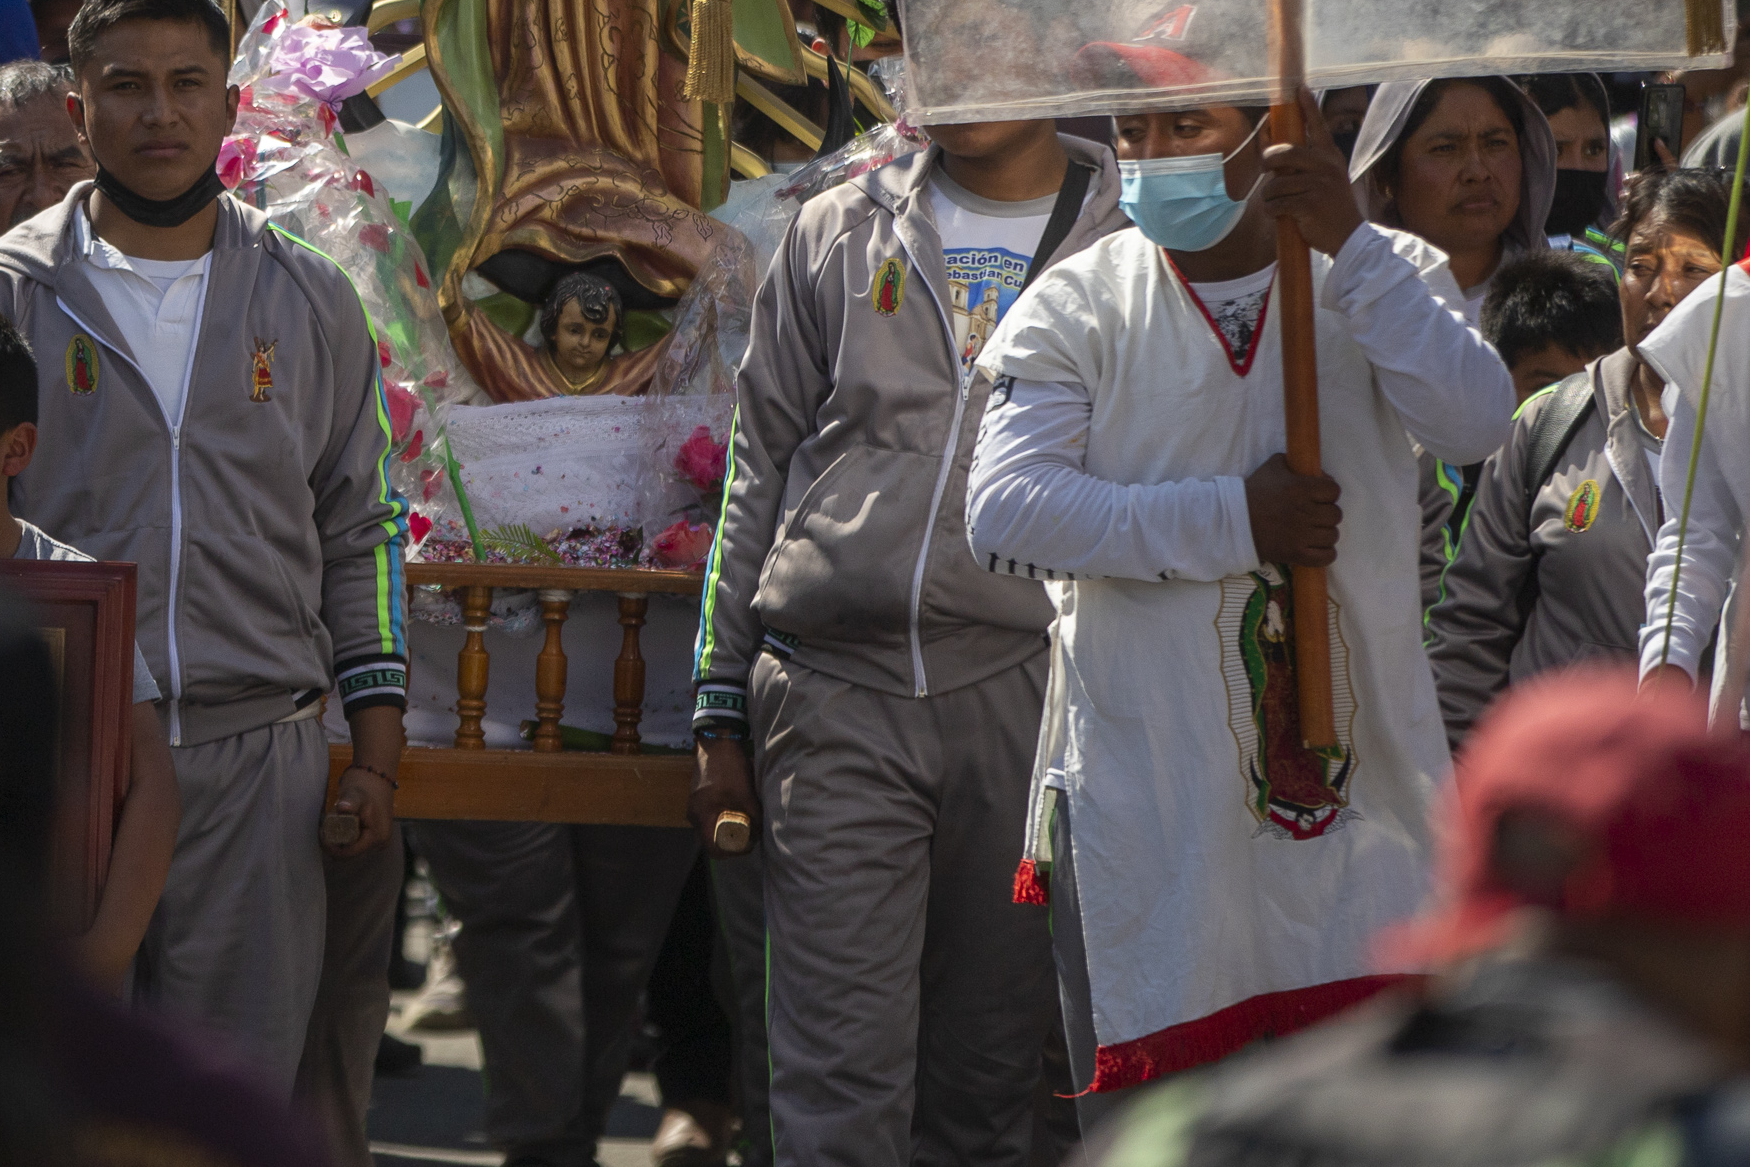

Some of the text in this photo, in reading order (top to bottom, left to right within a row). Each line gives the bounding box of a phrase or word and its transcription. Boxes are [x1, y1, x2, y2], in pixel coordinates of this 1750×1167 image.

[1132, 4, 1197, 42] A
[944, 253, 1024, 272] ación en
